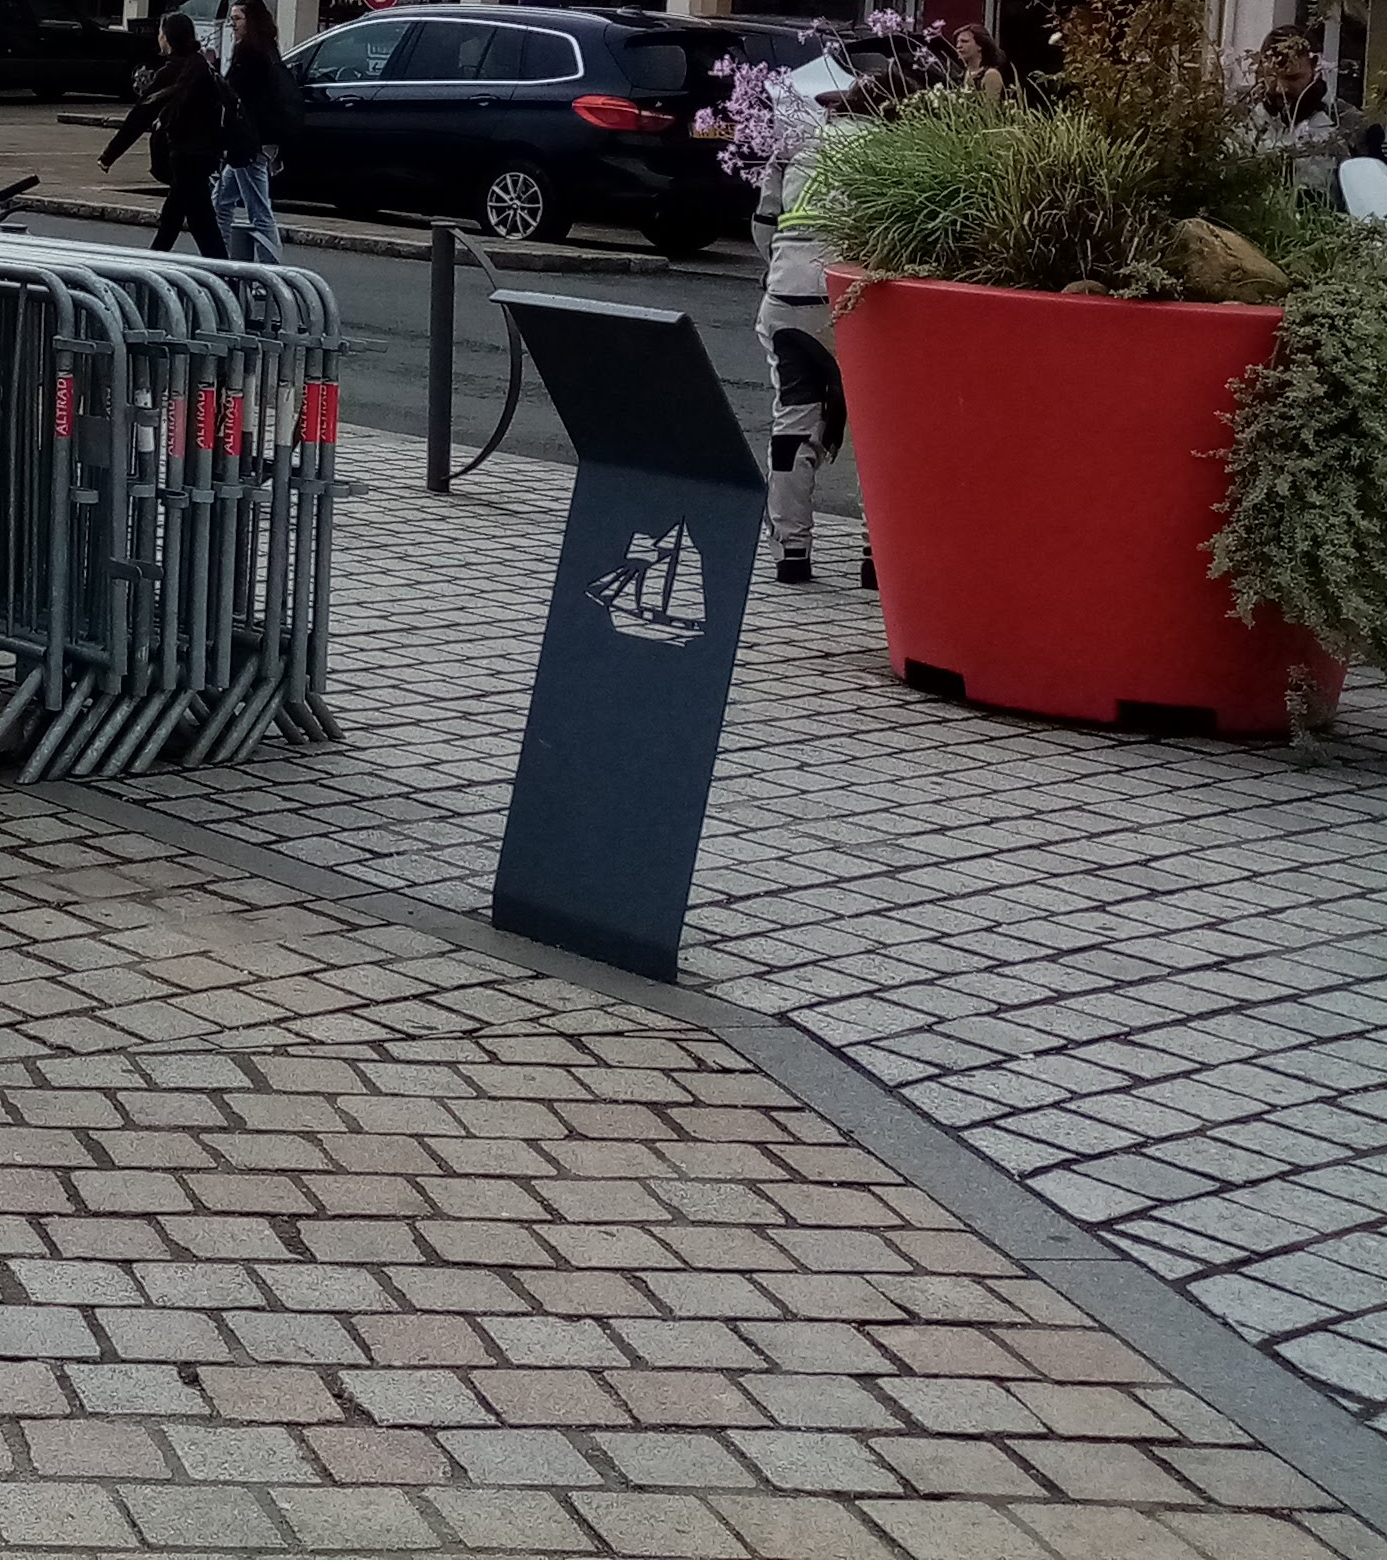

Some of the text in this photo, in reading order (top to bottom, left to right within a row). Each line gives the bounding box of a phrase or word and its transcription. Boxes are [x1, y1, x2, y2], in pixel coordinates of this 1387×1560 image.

[55, 378, 68, 436] ALTRAD
[195, 389, 206, 449] ALTRAD
[223, 395, 236, 456] ALTRAD
